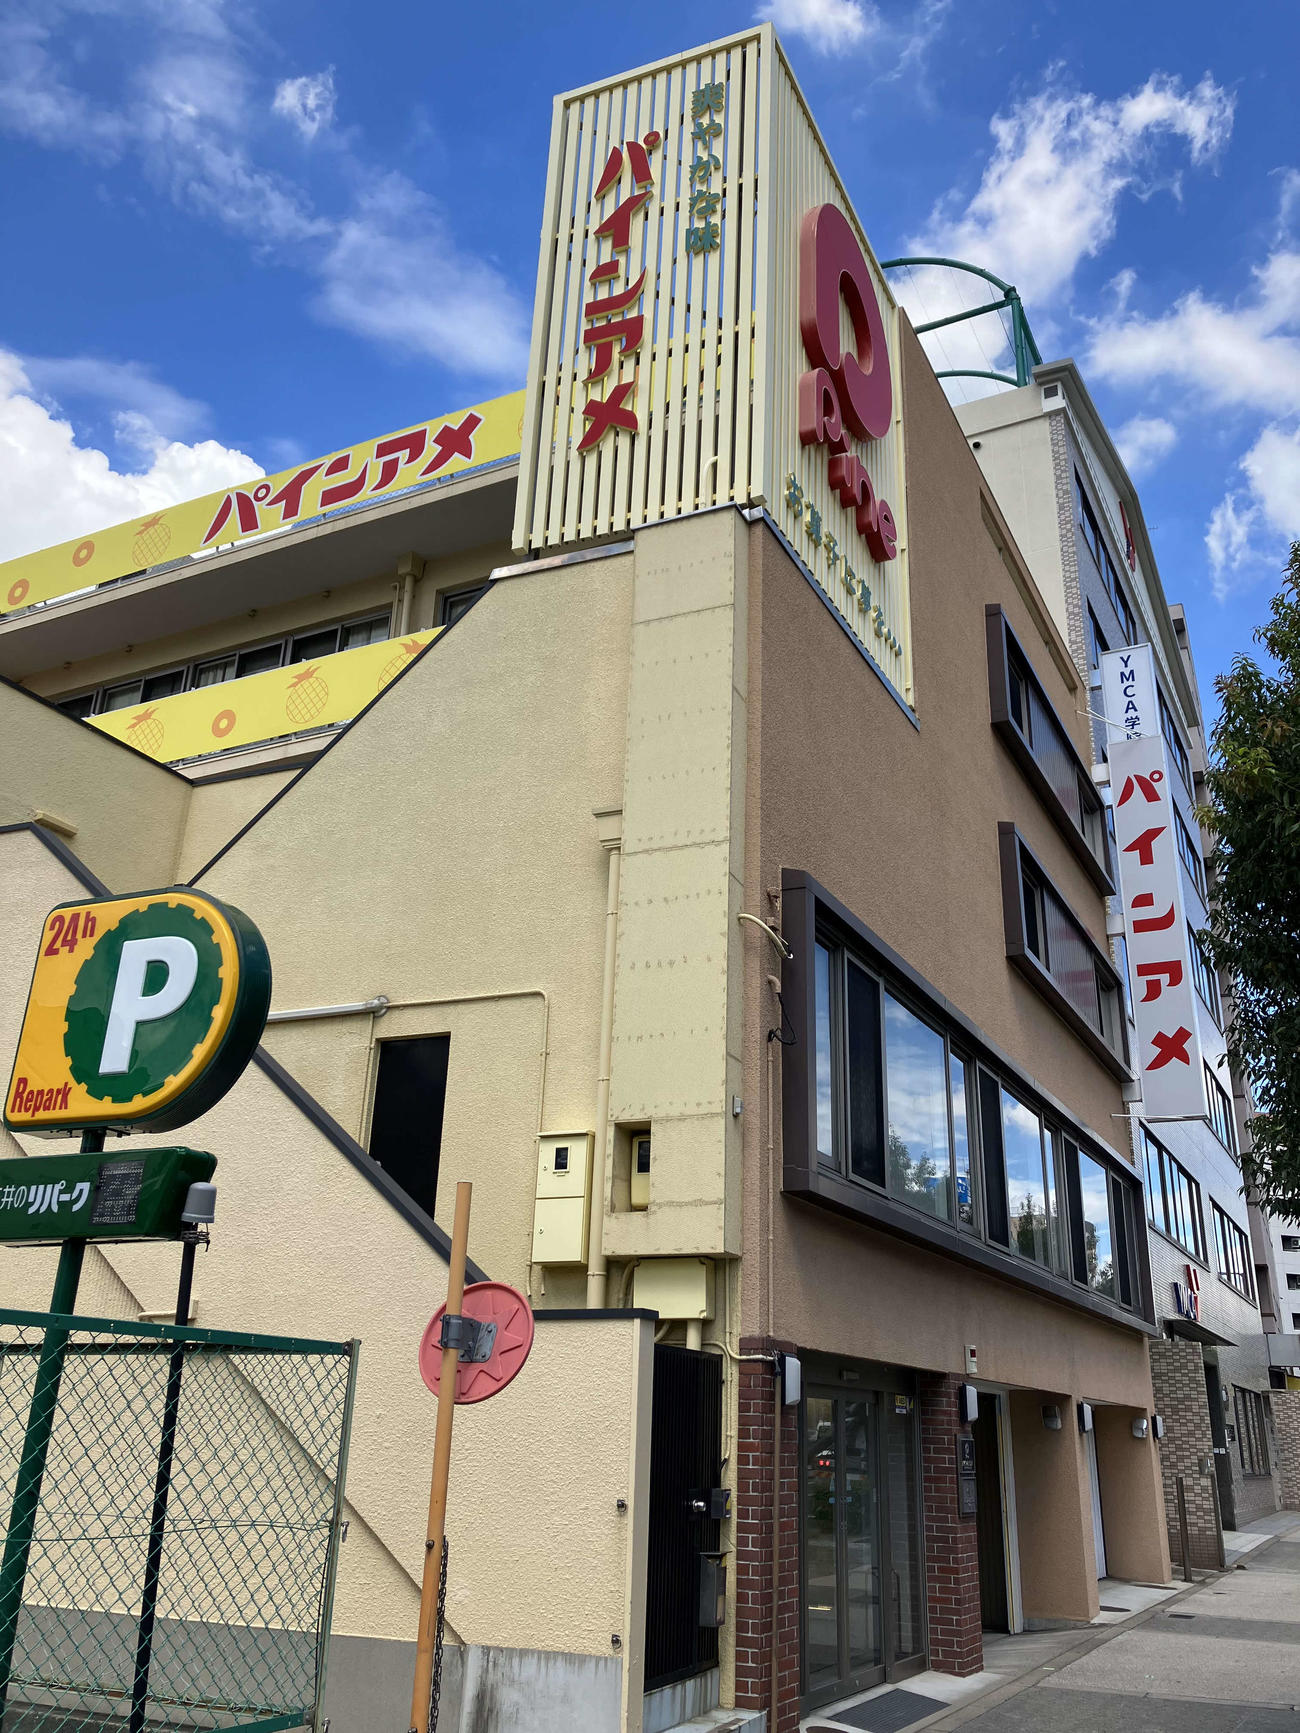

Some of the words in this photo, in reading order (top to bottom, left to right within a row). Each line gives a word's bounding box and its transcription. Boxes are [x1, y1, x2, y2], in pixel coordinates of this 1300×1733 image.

[577, 131, 661, 452] パインアメ
[202, 410, 483, 545] パインアメ
[799, 367, 897, 567] Pine
[44, 911, 96, 957] 24h
[1117, 768, 1192, 1070] パインアメ
[99, 936, 198, 1074] P
[10, 1077, 72, 1117] Repark
[0, 1180, 91, 1214] 井のリパーク
